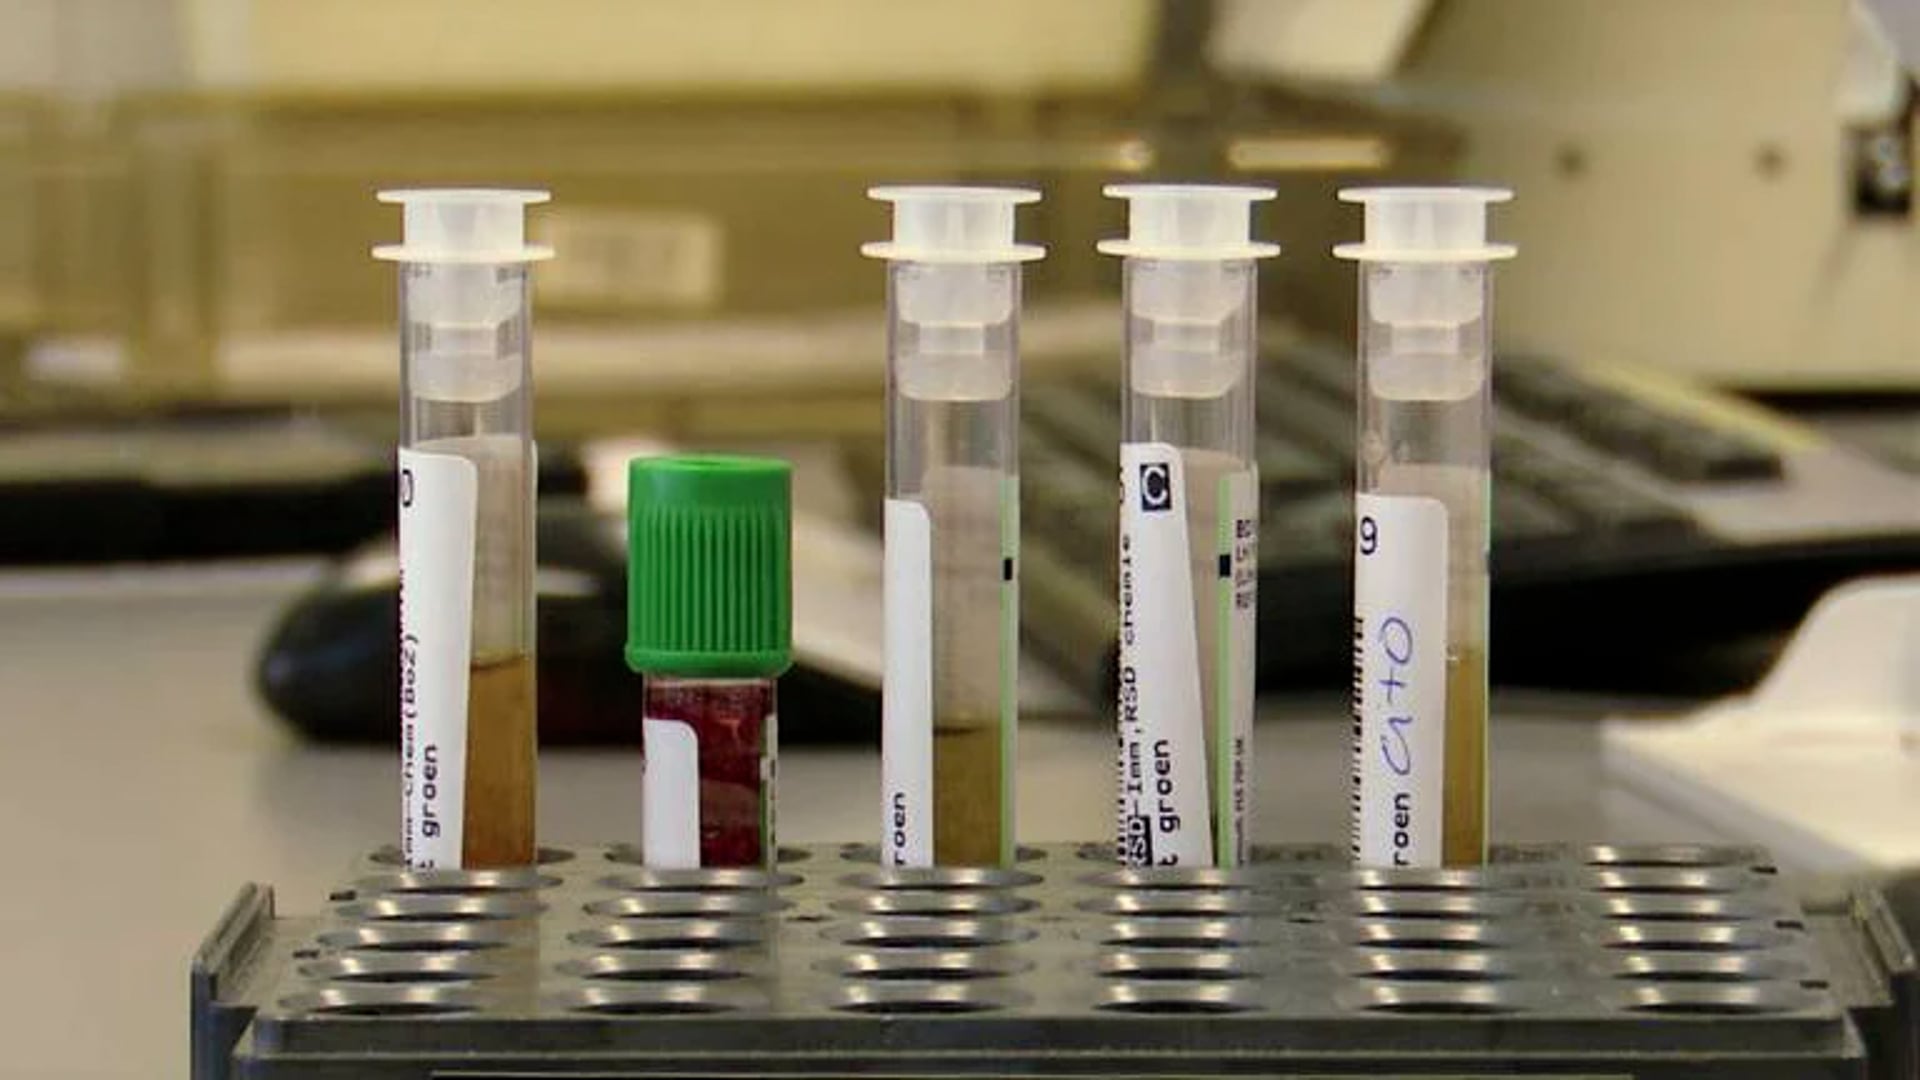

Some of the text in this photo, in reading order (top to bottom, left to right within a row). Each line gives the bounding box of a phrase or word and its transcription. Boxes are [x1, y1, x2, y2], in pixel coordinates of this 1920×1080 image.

[1142, 465, 1168, 505] C
[1360, 516, 1378, 556] 9
[421, 744, 440, 838] groen
[1154, 739, 1180, 833] groen
[893, 791, 907, 866] roen
[1393, 792, 1411, 867] roen
